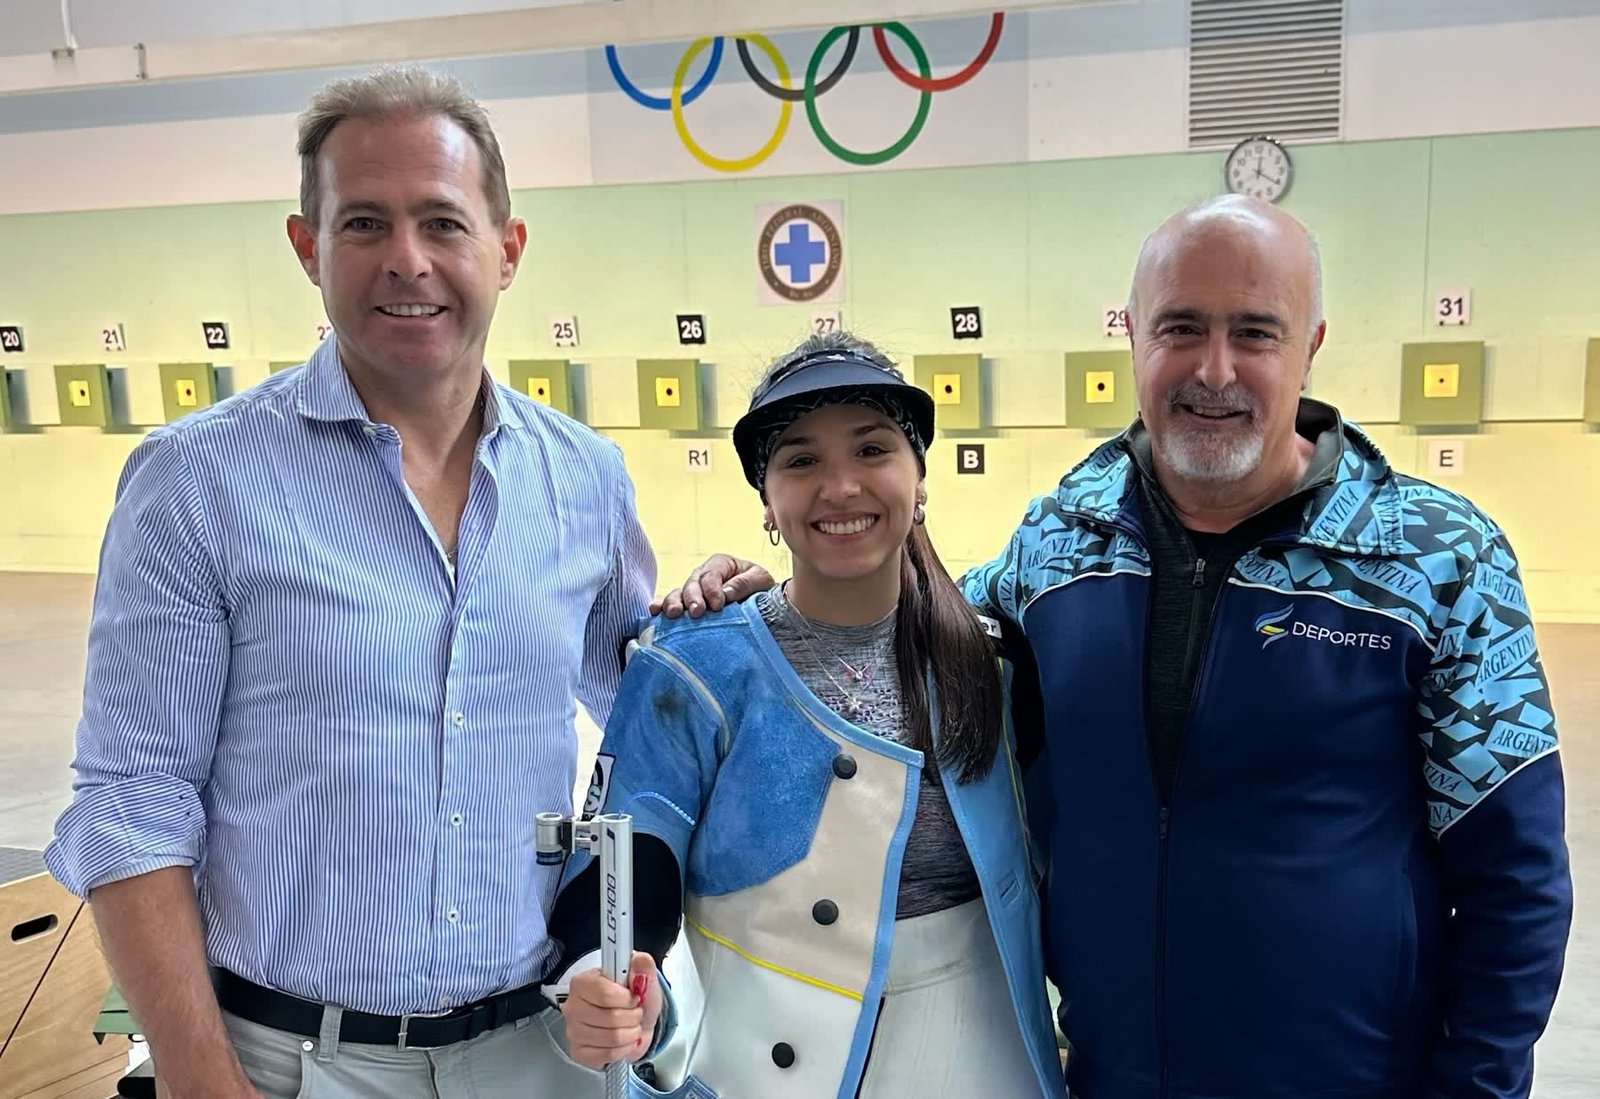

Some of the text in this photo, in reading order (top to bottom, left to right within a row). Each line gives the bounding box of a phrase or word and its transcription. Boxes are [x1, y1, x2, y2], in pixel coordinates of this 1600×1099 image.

[1439, 297, 1463, 316] 31
[553, 323, 573, 339] 25
[680, 320, 702, 339] 26
[815, 318, 835, 334] 27
[954, 314, 978, 333] 28
[2, 331, 20, 347] 20
[102, 329, 119, 345] 21
[206, 327, 226, 344] 22
[688, 450, 709, 466] R1
[963, 449, 979, 469] B
[1439, 449, 1454, 468] E
[1313, 485, 1359, 543] GENTINA
[1292, 621, 1392, 650] DEPORTES
[606, 872, 617, 945] LG400
